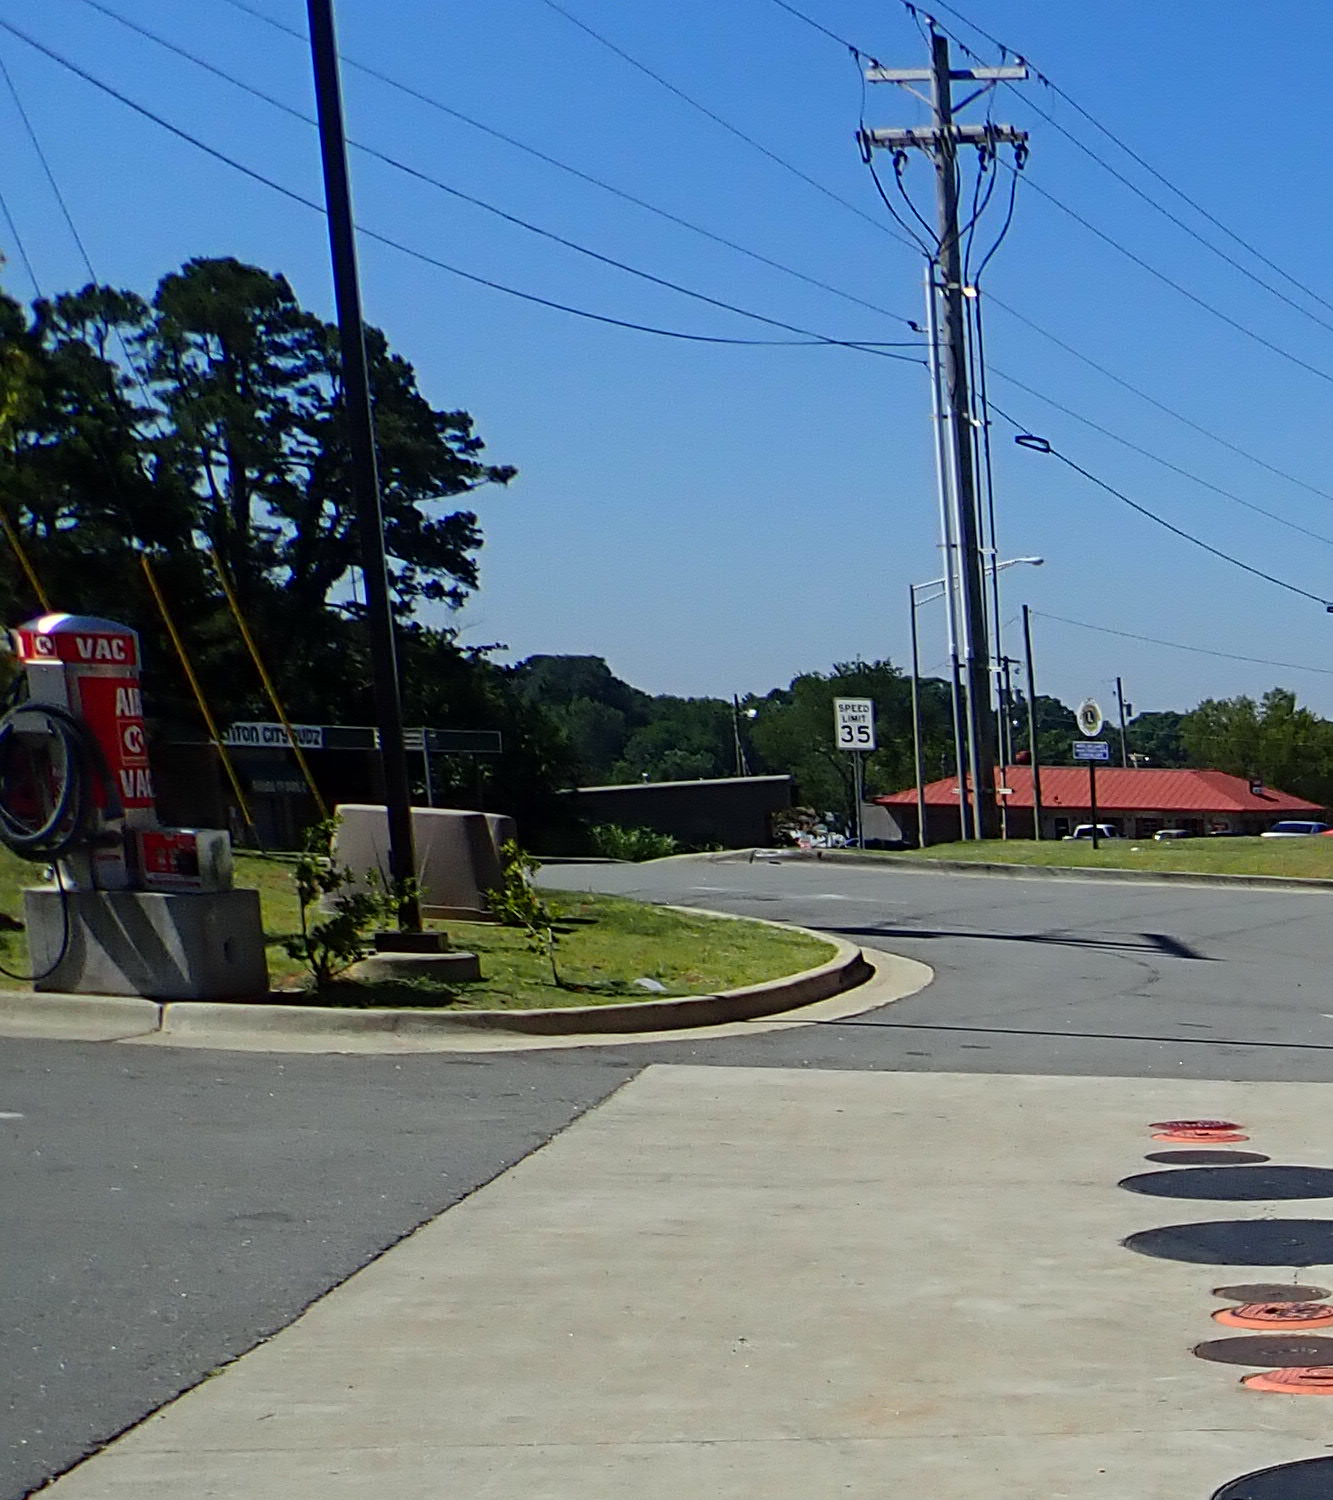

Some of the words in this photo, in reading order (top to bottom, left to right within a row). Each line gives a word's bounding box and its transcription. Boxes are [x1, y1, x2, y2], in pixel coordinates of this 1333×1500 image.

[75, 637, 126, 660] VAC
[838, 704, 870, 713] SPEED
[842, 715, 866, 723] LIMIT
[841, 725, 870, 743] 35
